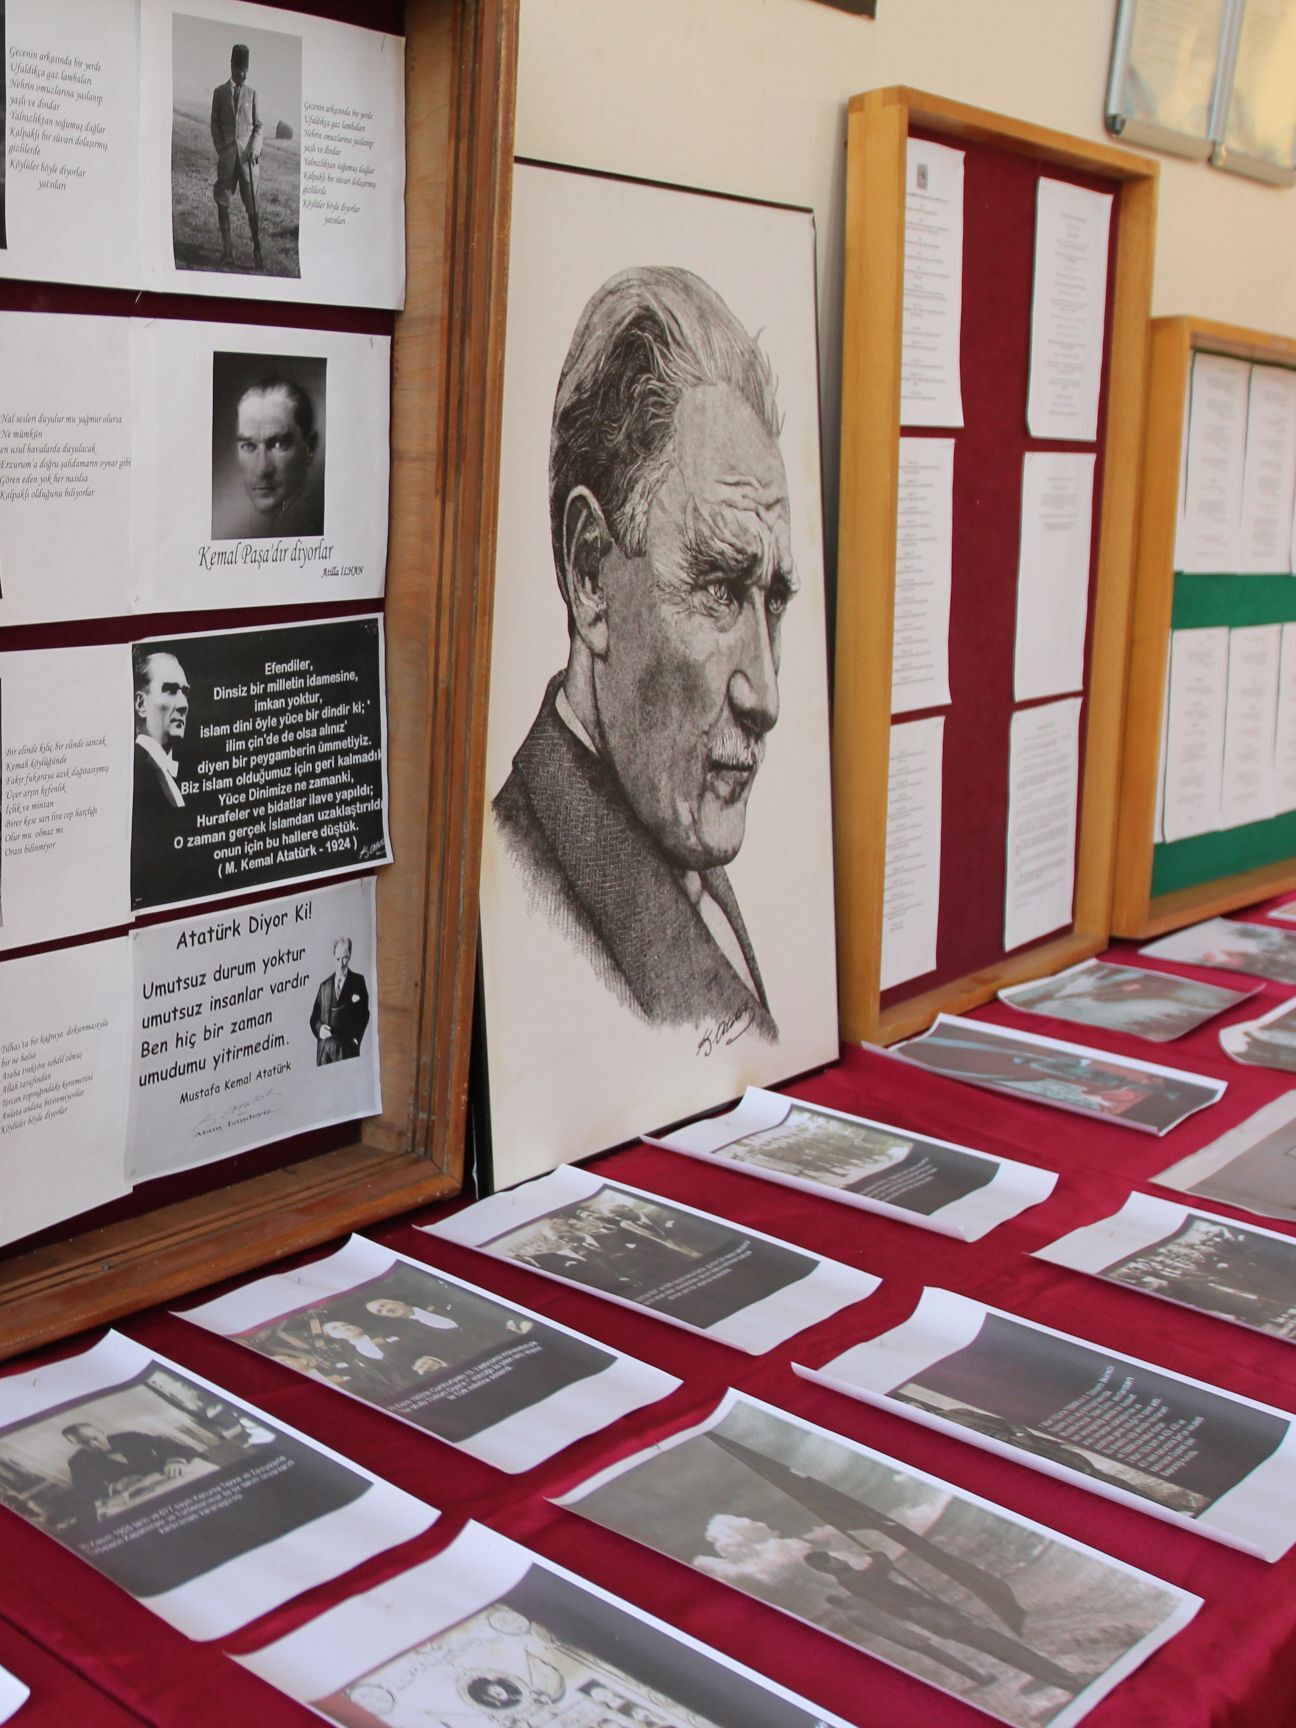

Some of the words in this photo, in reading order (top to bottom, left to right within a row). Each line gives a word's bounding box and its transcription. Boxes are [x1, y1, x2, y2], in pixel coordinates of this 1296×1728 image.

[198, 542, 240, 570] Kemal
[242, 541, 288, 568] Paşa'dır
[291, 539, 334, 568] diyorlar
[265, 659, 313, 675] Efendiler,
[214, 684, 247, 700] Dinsiz
[250, 682, 265, 695] bir
[268, 676, 304, 692] milletin
[288, 692, 322, 710] yoktur,
[233, 718, 252, 733] dini
[255, 716, 277, 731] öyle
[279, 713, 303, 728] yüce
[306, 709, 319, 721] bir
[322, 704, 350, 718] dindir
[198, 760, 229, 774] diyen
[233, 755, 248, 768] bir
[250, 743, 315, 767] peygamberin
[318, 735, 371, 753] ümmetiyiz.
[248, 733, 279, 750] çin'de
[281, 730, 294, 742] de
[296, 727, 316, 739] olsa
[181, 781, 199, 797] Biz
[236, 767, 291, 785] olduğumuz
[295, 761, 312, 777] için
[315, 756, 334, 773] geri
[218, 793, 246, 806] Yüce
[249, 783, 292, 801] Dinimize
[295, 781, 306, 791] ne
[309, 770, 353, 789] zamanki,
[197, 809, 250, 827] Hurafeler
[253, 807, 265, 816] ve
[268, 797, 306, 814] bidatlar
[309, 793, 333, 805] ilave
[336, 785, 373, 803] yapıldı;
[174, 836, 183, 849] O
[187, 832, 225, 847] zaman
[229, 821, 266, 840] gerçek
[214, 846, 241, 859] onun
[245, 840, 263, 855] için
[266, 837, 279, 848] bu
[282, 830, 318, 845] hallere
[321, 820, 358, 837] düştük.
[226, 861, 237, 874] M.
[241, 852, 273, 871] Kemal
[277, 844, 317, 863] Atatürk
[326, 837, 351, 852] 1924
[177, 919, 240, 950] Atatürk
[249, 913, 288, 934] Diyor
[296, 902, 311, 923] Ki!
[143, 973, 206, 999] Umutsuz
[214, 961, 256, 982] durum
[263, 948, 305, 975] yoktur
[142, 1003, 202, 1029] umutsuz
[210, 986, 263, 1011] insanlar
[270, 974, 309, 995] vardır
[141, 1041, 167, 1058] Ben
[176, 1031, 196, 1049] hiç
[204, 1023, 223, 1041] bir
[230, 1011, 272, 1034] zaman
[139, 1058, 206, 1087] umudumu
[213, 1036, 289, 1071] yitirmedim.
[180, 1083, 220, 1104] Mustafa
[225, 1072, 251, 1091] Kemal
[256, 1061, 291, 1081] Atatürk
